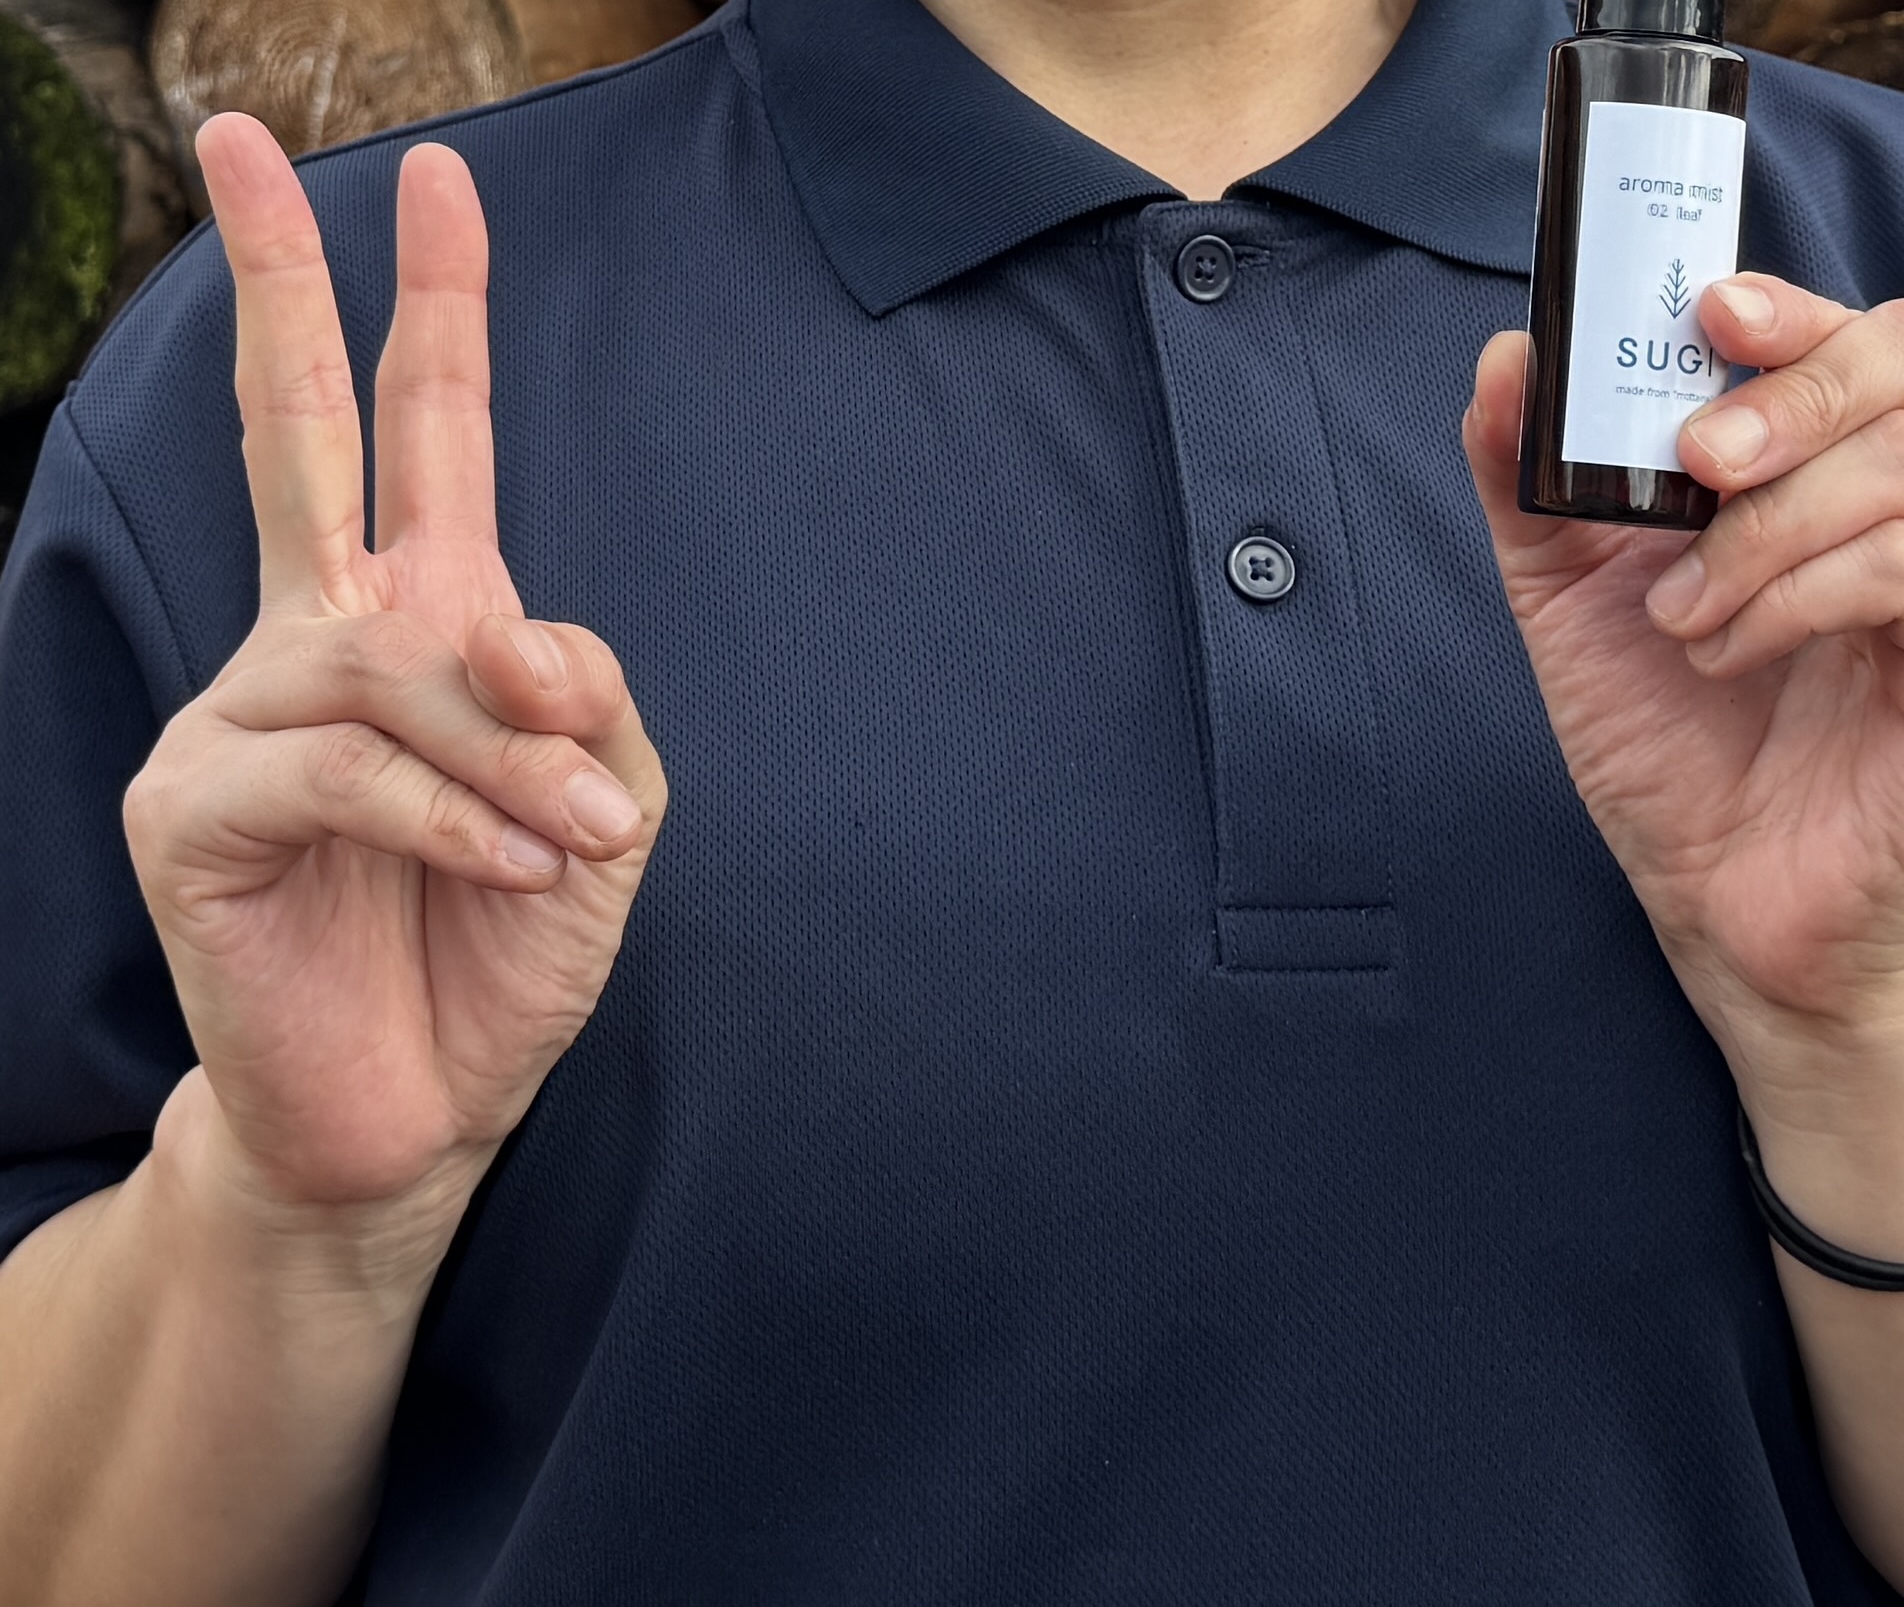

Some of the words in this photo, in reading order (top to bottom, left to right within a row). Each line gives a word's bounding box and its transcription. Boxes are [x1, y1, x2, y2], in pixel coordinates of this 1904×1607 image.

[1618, 176, 1684, 196] aroma
[1688, 183, 1724, 203] mist
[1647, 203, 1669, 218] 02
[1616, 336, 1714, 378] SUGI
[1615, 384, 1645, 396] made
[1647, 387, 1670, 399] from
